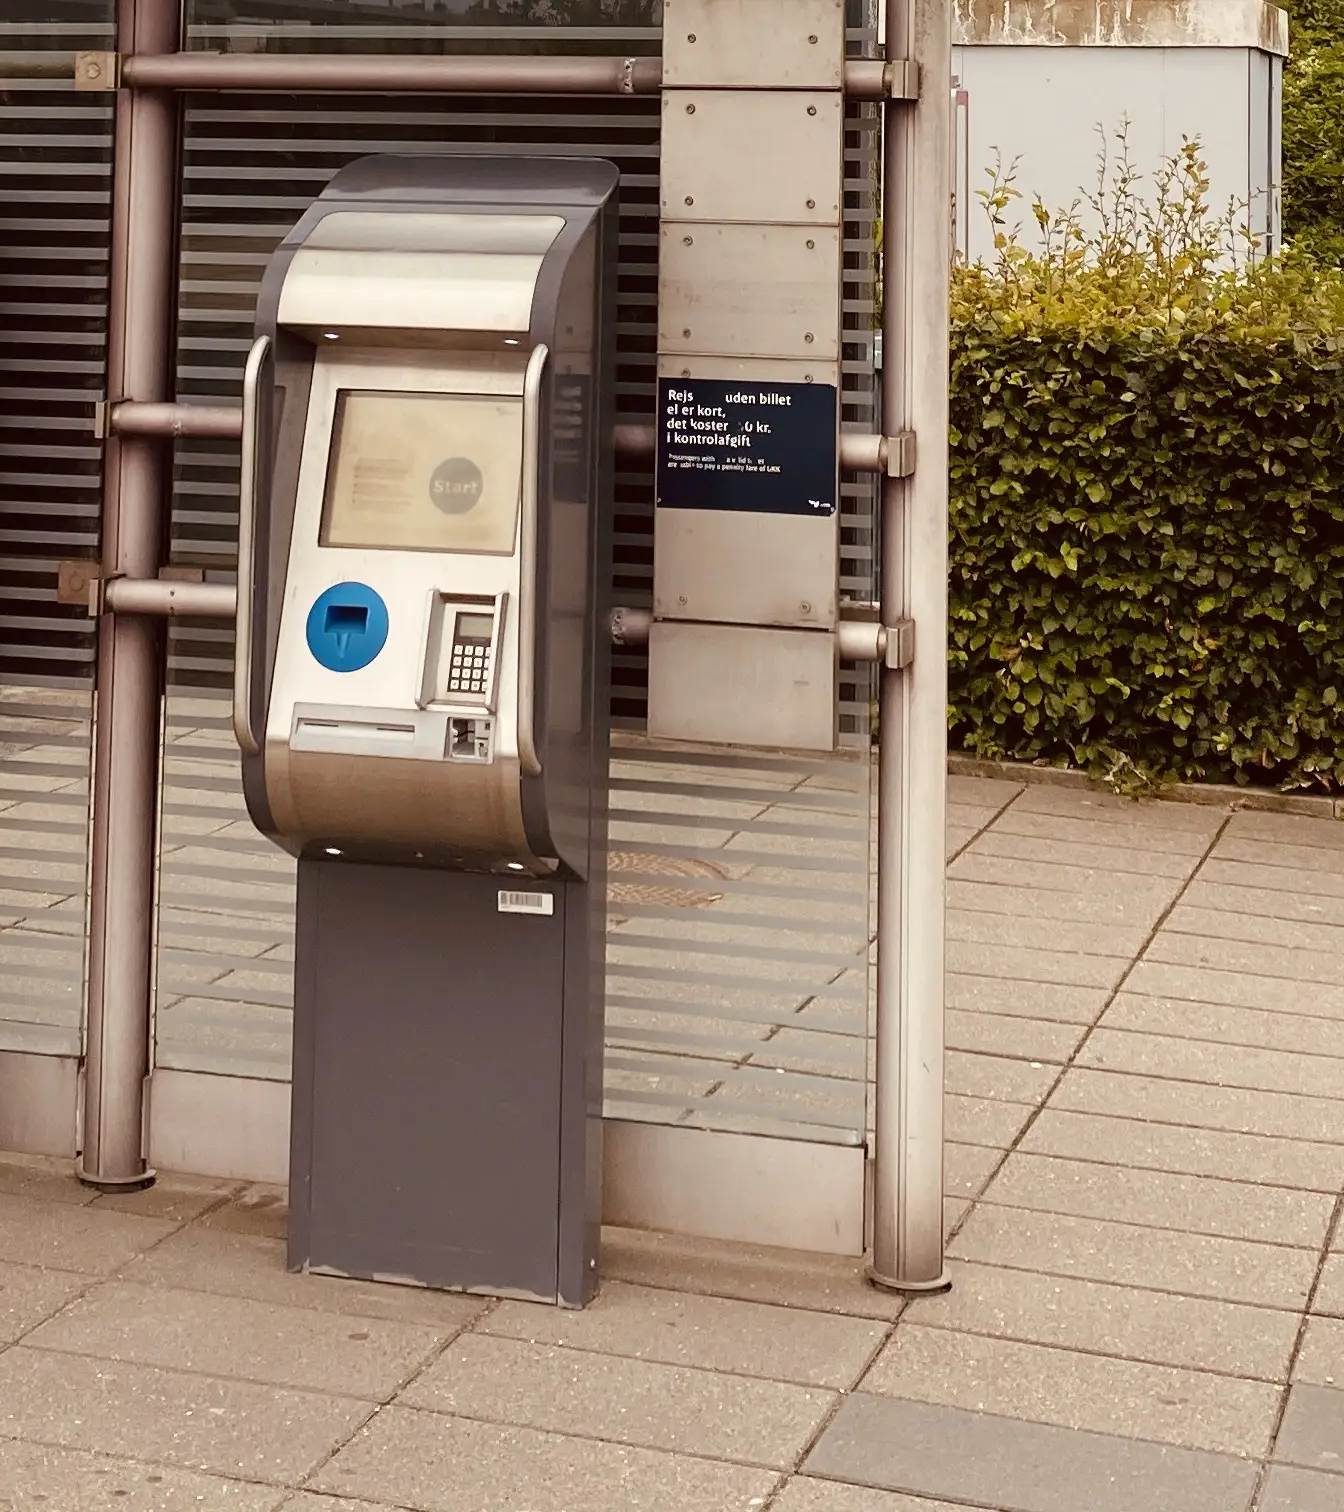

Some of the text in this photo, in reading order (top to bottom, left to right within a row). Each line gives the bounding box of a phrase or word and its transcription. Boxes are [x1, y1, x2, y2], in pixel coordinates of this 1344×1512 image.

[725, 392, 756, 405] uden
[759, 393, 792, 406] billet
[697, 406, 726, 418] kort,
[666, 418, 772, 433] det koster kr.
[674, 432, 751, 448] kontrolafgift
[433, 479, 479, 494] Start
